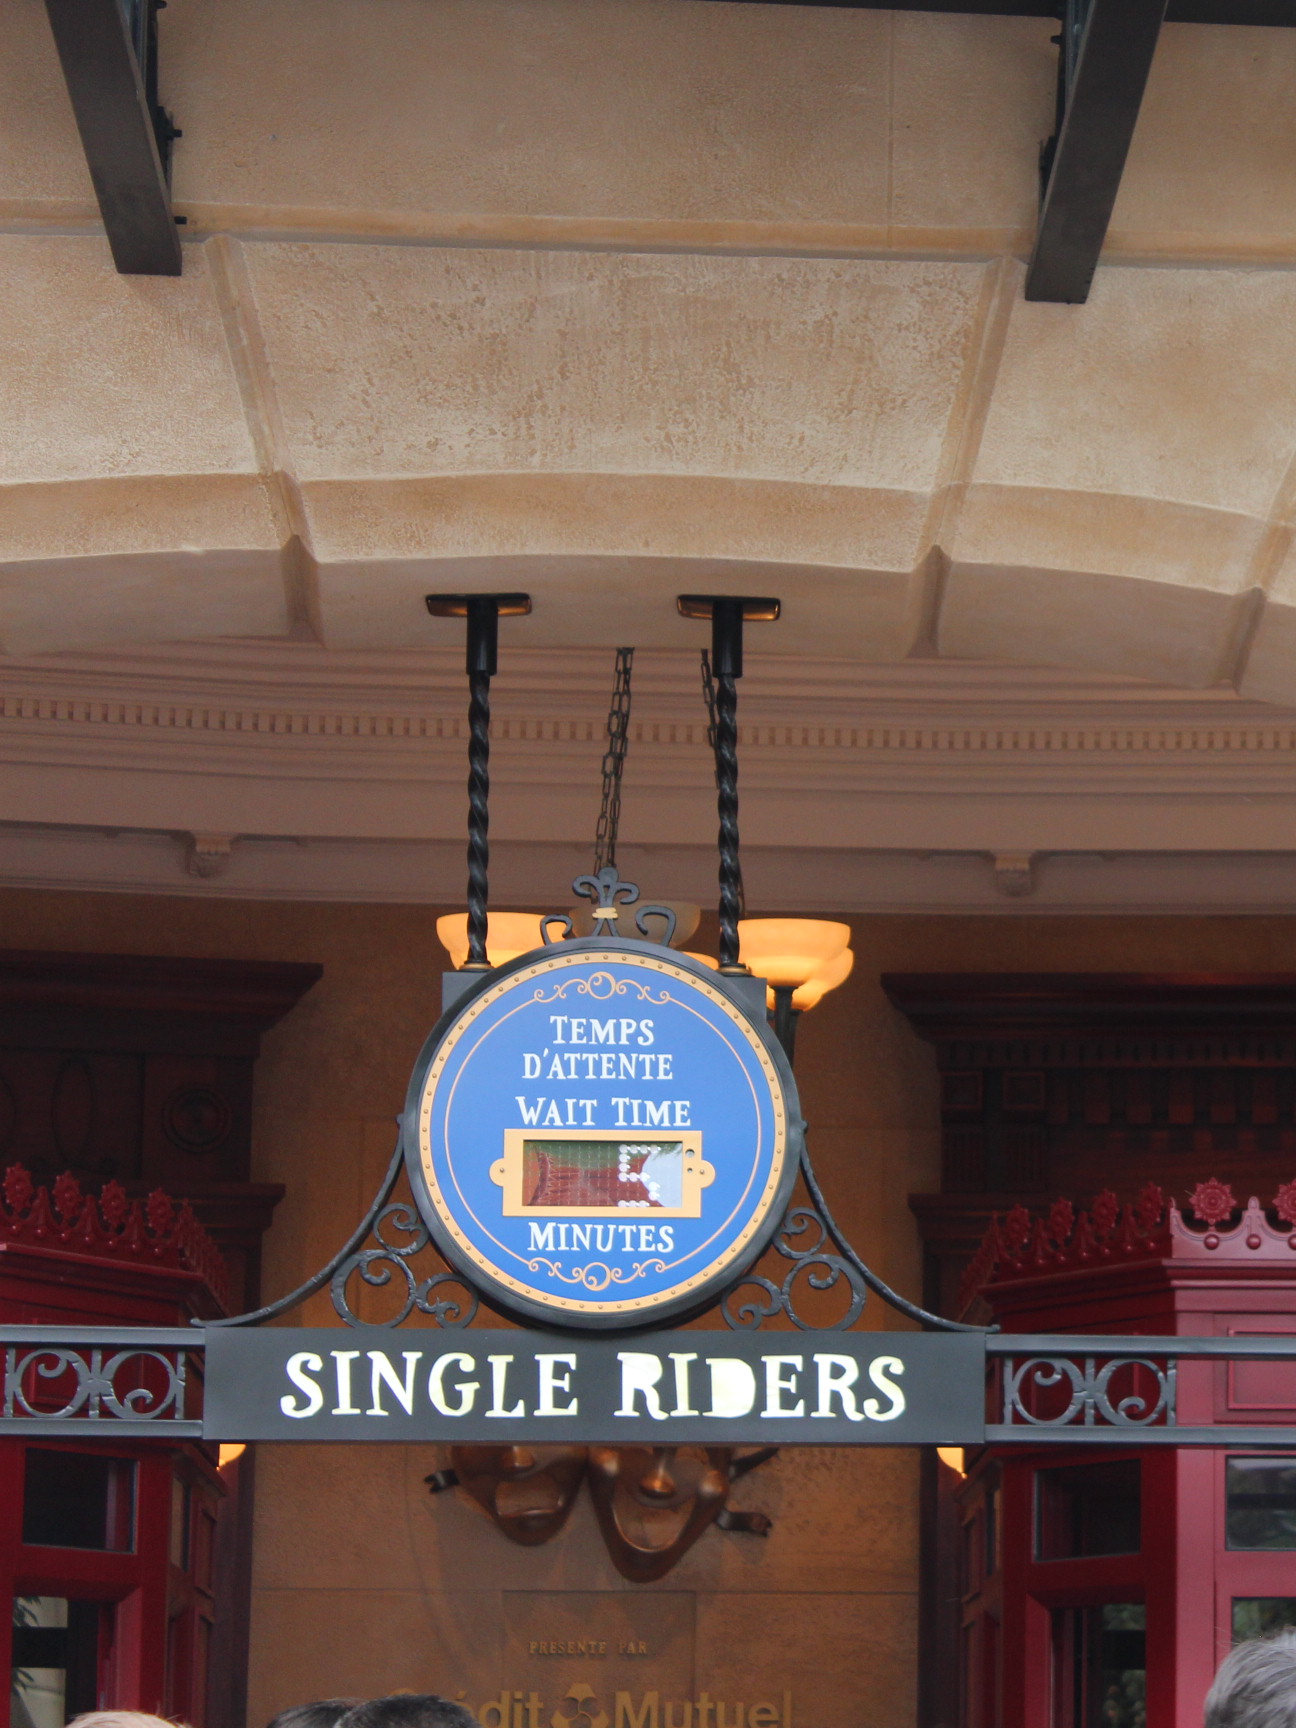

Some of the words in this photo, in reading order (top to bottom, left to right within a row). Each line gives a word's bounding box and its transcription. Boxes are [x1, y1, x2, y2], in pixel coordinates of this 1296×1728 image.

[550, 1015, 655, 1046] TEMPS
[522, 1048, 674, 1080] D'ATTENTE
[515, 1096, 598, 1126] WAIT
[611, 1097, 691, 1127] TIME
[618, 1144, 661, 1208] 5
[527, 1222, 675, 1253] MINUTES
[280, 1350, 579, 1419] SINGLE
[613, 1351, 906, 1422] RIDERS
[618, 1640, 649, 1655] PAR
[614, 1689, 792, 1728] Mutuel
